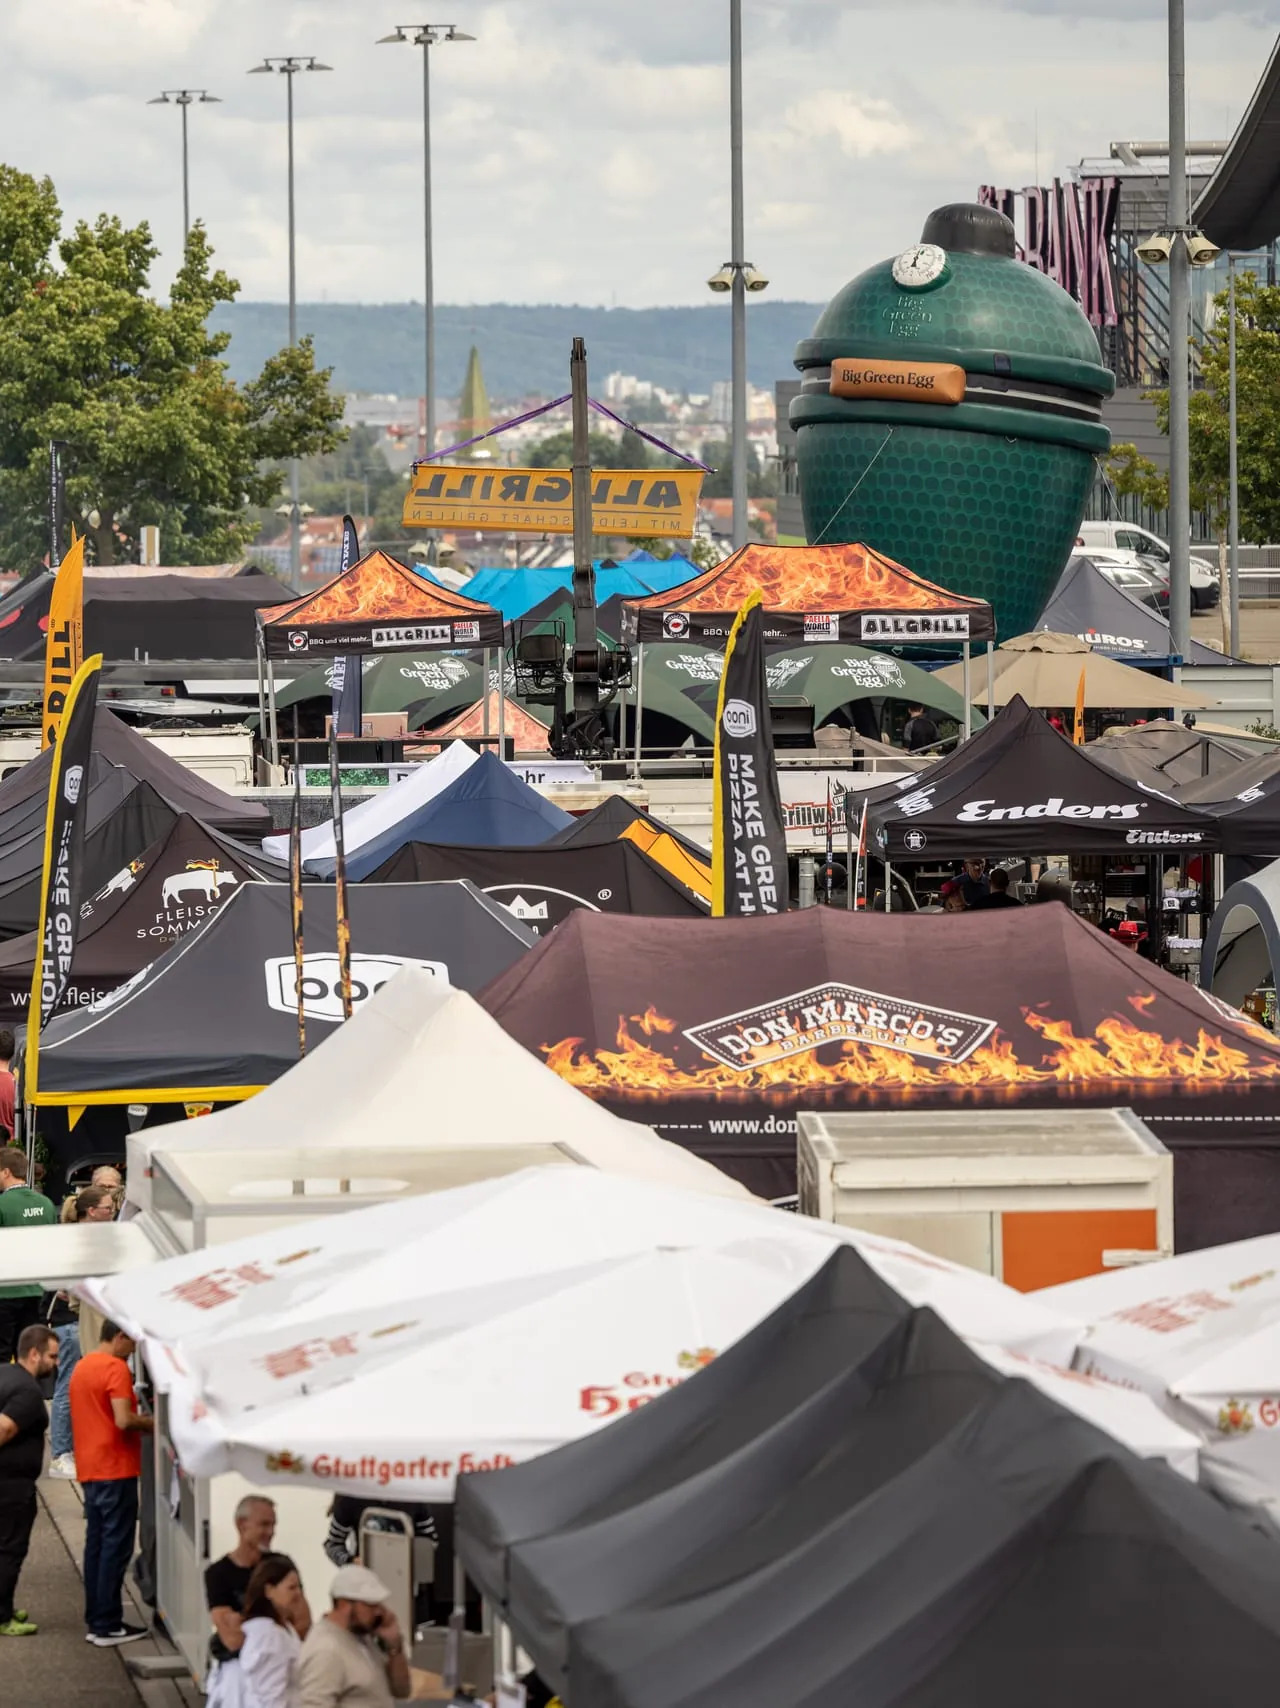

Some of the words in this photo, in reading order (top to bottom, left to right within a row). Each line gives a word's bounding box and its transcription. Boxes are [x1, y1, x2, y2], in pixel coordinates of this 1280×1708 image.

[842, 369, 861, 385] Big
[864, 371, 905, 385] Green
[907, 372, 936, 389] Egg
[804, 615, 830, 623] PAELLA
[703, 628, 722, 637] BBQ
[804, 622, 830, 631] WORLD
[864, 618, 967, 636] ALLGRILL
[375, 627, 449, 642] ALLGRILL
[414, 661, 439, 672] Big
[666, 659, 709, 671] Green
[679, 654, 704, 665] Big
[843, 658, 871, 669] Big
[400, 668, 447, 678] Green
[687, 668, 717, 682] Egg
[831, 665, 876, 678] Green
[423, 678, 452, 690] Egg
[853, 674, 883, 688] Egg
[727, 710, 750, 724] ooni
[728, 753, 743, 840] PIZZA
[740, 754, 767, 839] MAKE
[956, 798, 1140, 822] Enders
[1125, 829, 1203, 844] Enders
[734, 846, 751, 885] AT
[751, 845, 778, 915] GREA
[137, 920, 202, 939] SOMM
[718, 1016, 797, 1055] DON
[801, 999, 964, 1048] MARCO'S
[780, 1024, 908, 1051] BARBECUE
[709, 1115, 798, 1134] www.don
[22, 1206, 44, 1218] JURY
[312, 1454, 451, 1486] Stuttgarter
